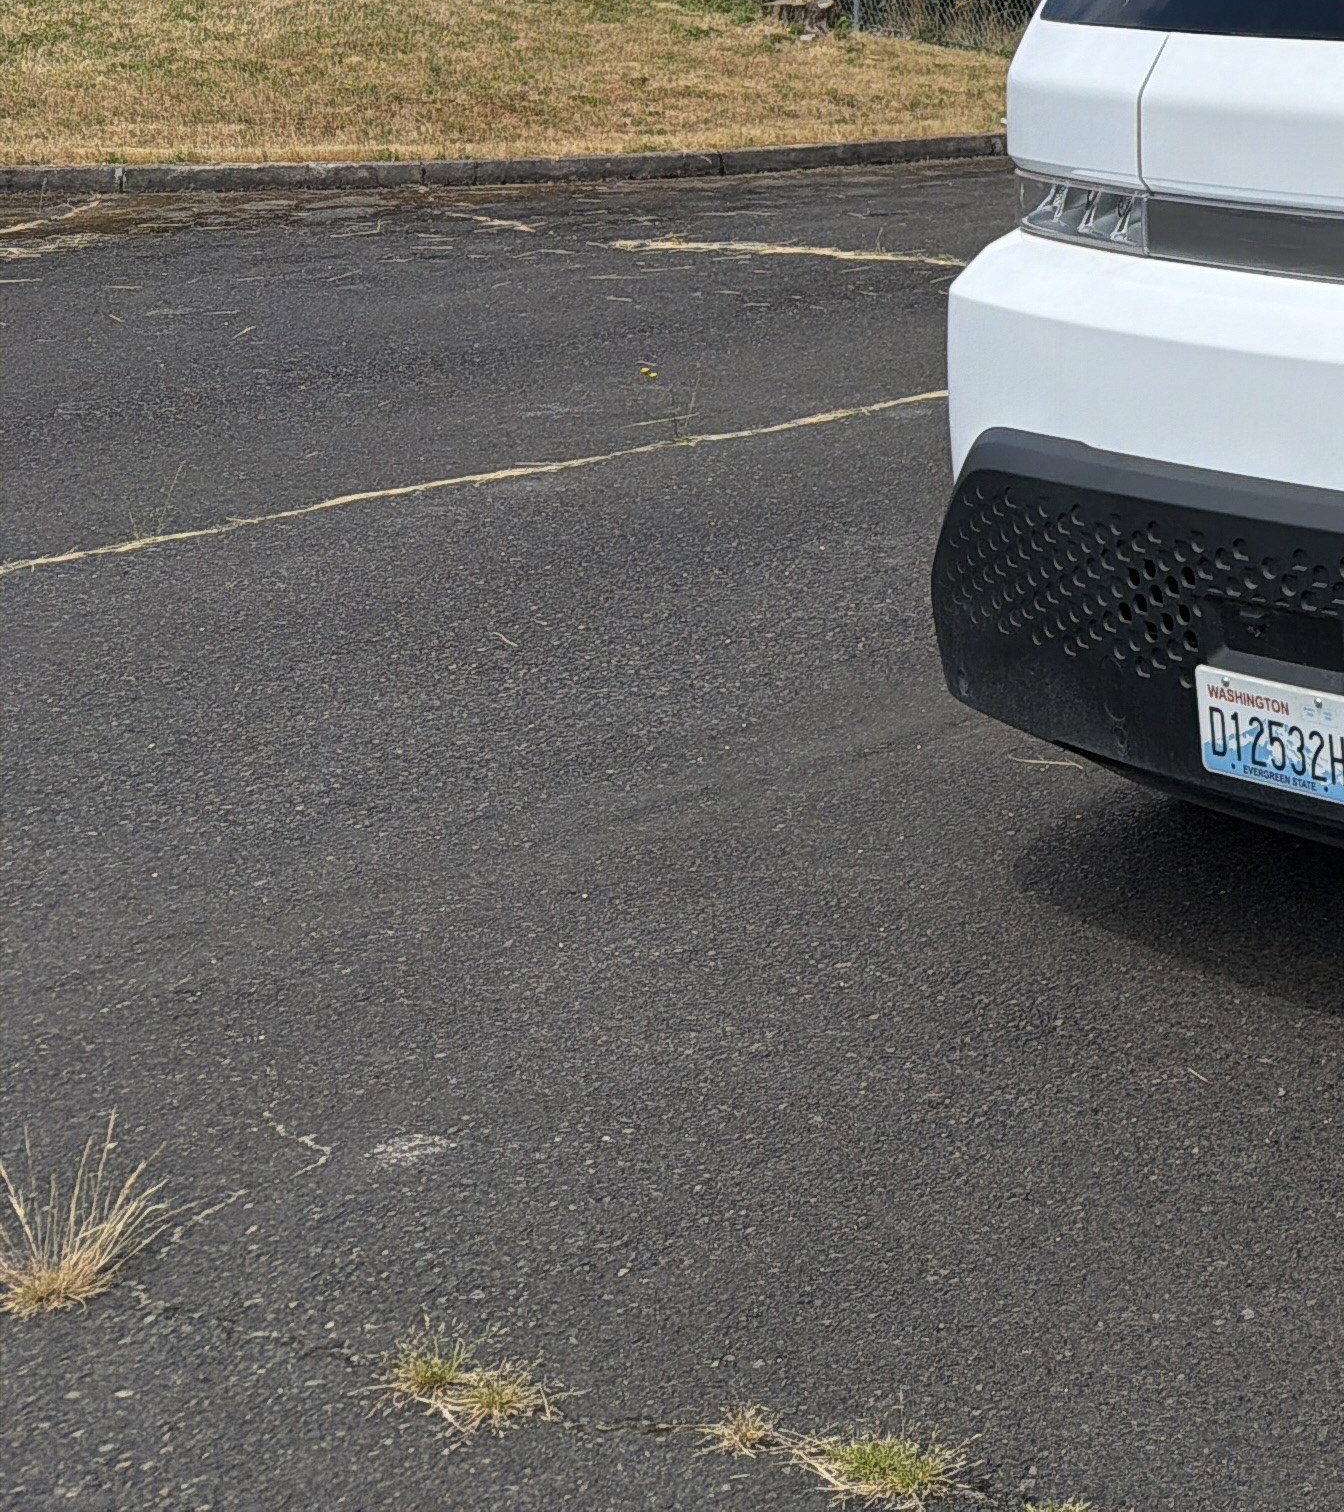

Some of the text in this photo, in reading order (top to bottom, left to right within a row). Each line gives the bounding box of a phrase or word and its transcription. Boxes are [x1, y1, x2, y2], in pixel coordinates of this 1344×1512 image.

[1207, 684, 1290, 716] WASHINGTON
[1243, 765, 1317, 792] EVERGREEN STATE
